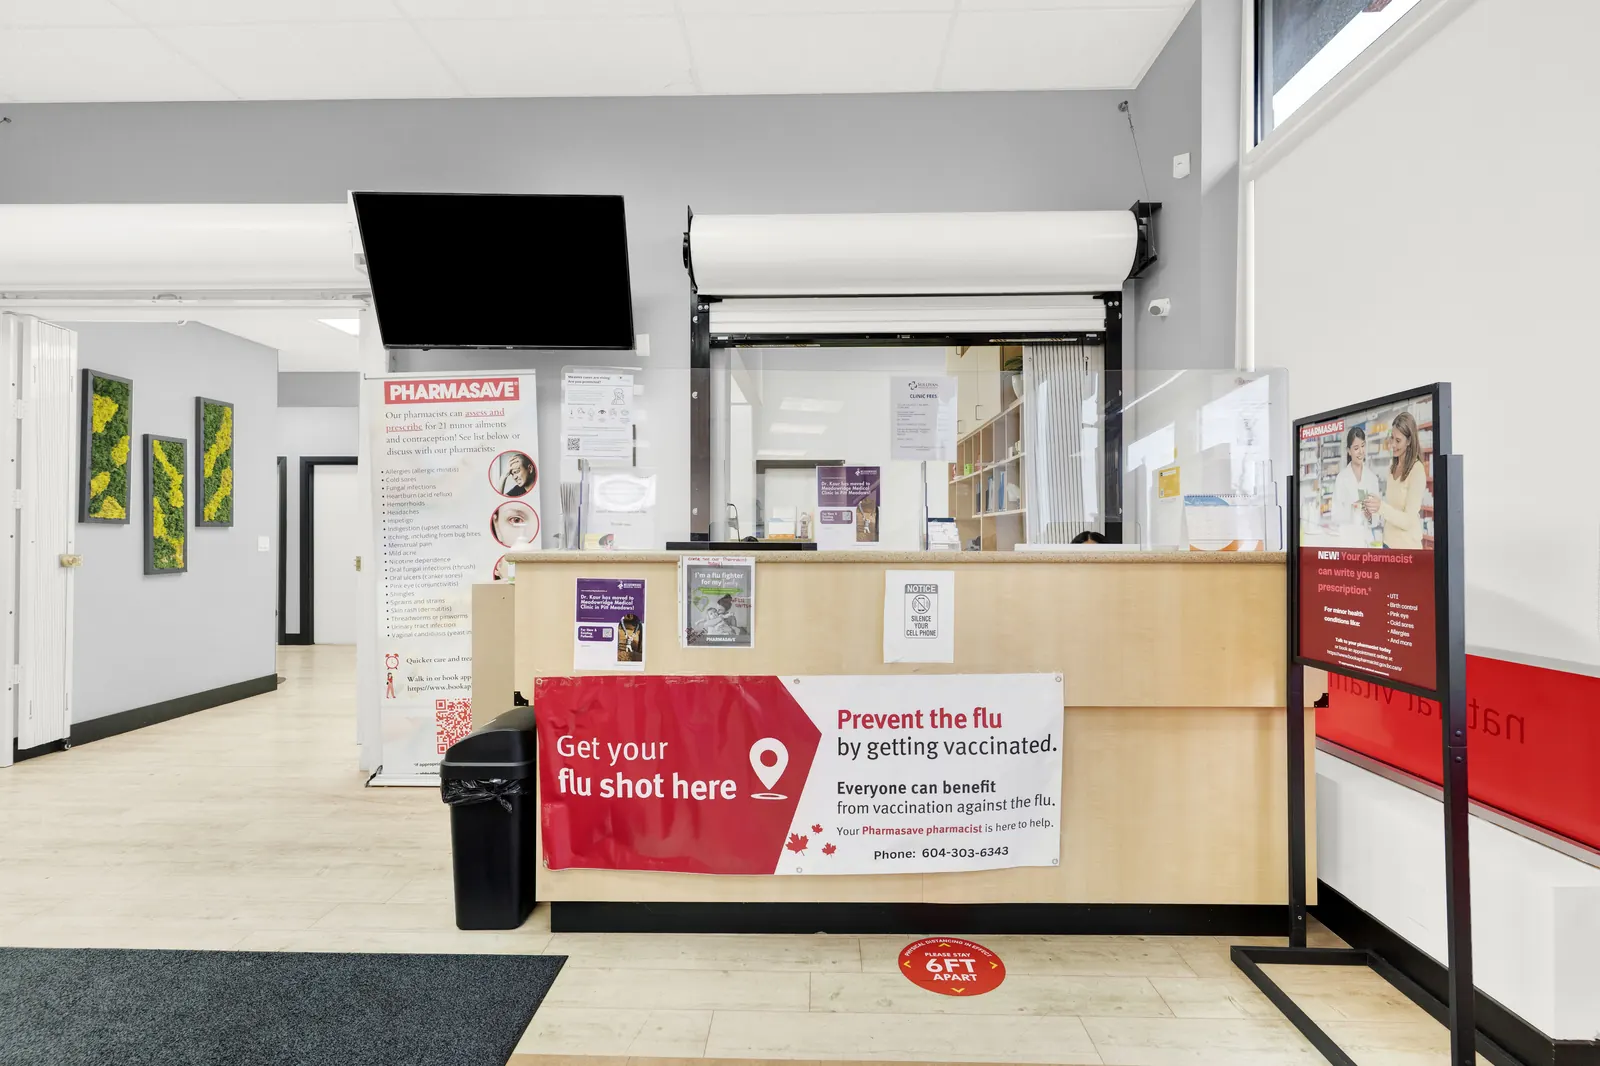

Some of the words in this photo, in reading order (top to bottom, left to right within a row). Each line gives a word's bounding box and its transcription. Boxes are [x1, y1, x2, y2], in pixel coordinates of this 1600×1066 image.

[390, 381, 514, 401] PHARMASAVE
[386, 411, 401, 419] Our
[404, 410, 447, 421] pharmacists
[386, 423, 423, 433] prescribe
[425, 422, 436, 430] for
[475, 420, 506, 428] ailments
[1302, 421, 1344, 438] PHARMASAVE
[386, 435, 400, 444] and
[402, 434, 457, 445] contraception!
[486, 432, 509, 440] below
[449, 446, 495, 456] pharmacists:
[1318, 551, 1340, 560] NEW!
[1341, 552, 1360, 561] Your
[1362, 552, 1413, 564] pharmacist
[1334, 568, 1355, 577] write
[1356, 570, 1372, 580] you
[837, 709, 924, 730] Prevent
[929, 707, 967, 729] the
[973, 707, 1003, 729] flu
[556, 735, 601, 760] Get
[607, 741, 669, 767] your
[837, 737, 862, 759] by
[867, 736, 939, 761] getting
[943, 733, 1058, 755] vaccinated.
[558, 768, 592, 797] flu
[599, 772, 665, 798] shot
[672, 772, 737, 800] here
[837, 781, 907, 799] Everyone
[911, 784, 937, 795] can
[942, 780, 996, 795] benefit
[837, 800, 869, 815] from
[873, 800, 953, 815] vaccination
[957, 799, 1008, 816] against
[1010, 796, 1031, 810] the
[1034, 794, 1056, 807] flu.
[837, 827, 860, 836] Your
[862, 826, 924, 836] Pharmasave
[926, 824, 983, 837] pharmacist
[985, 824, 993, 833] is
[996, 822, 1016, 832] here
[1018, 821, 1027, 830] to
[1029, 818, 1054, 831] help.
[874, 850, 916, 860] Phone:
[922, 847, 1009, 858] 604-303-6343
[971, 943, 993, 958] EFFECT
[925, 958, 977, 973] 6FT
